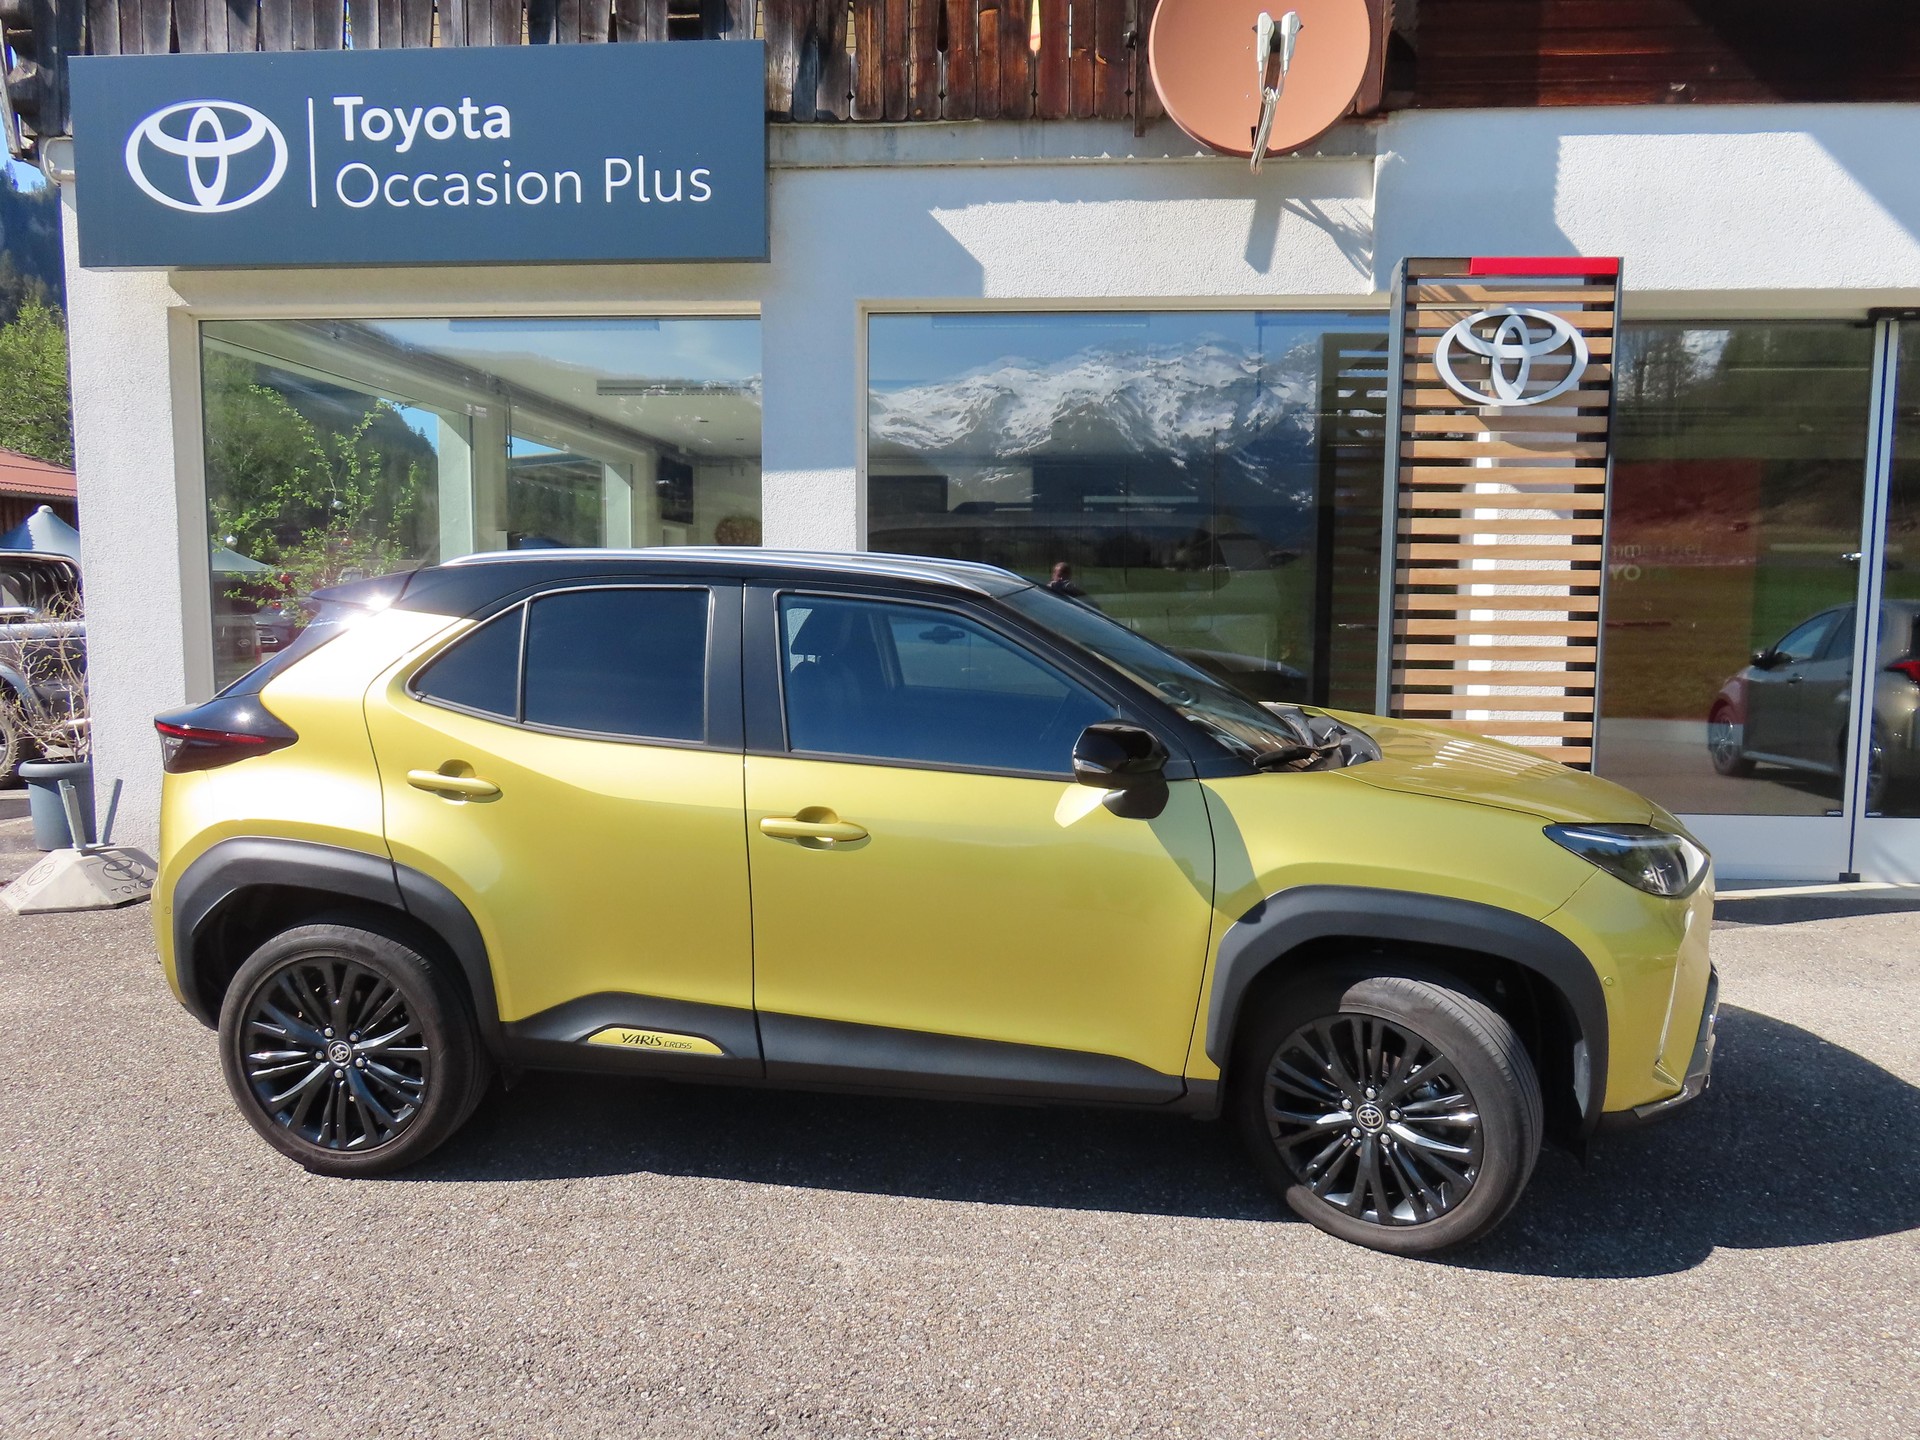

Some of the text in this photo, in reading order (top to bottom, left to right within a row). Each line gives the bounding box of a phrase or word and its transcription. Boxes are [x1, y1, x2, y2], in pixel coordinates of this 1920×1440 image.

[333, 96, 511, 153] Toyota
[336, 155, 712, 208] Occasion Plus
[663, 1040, 692, 1050] CROSS
